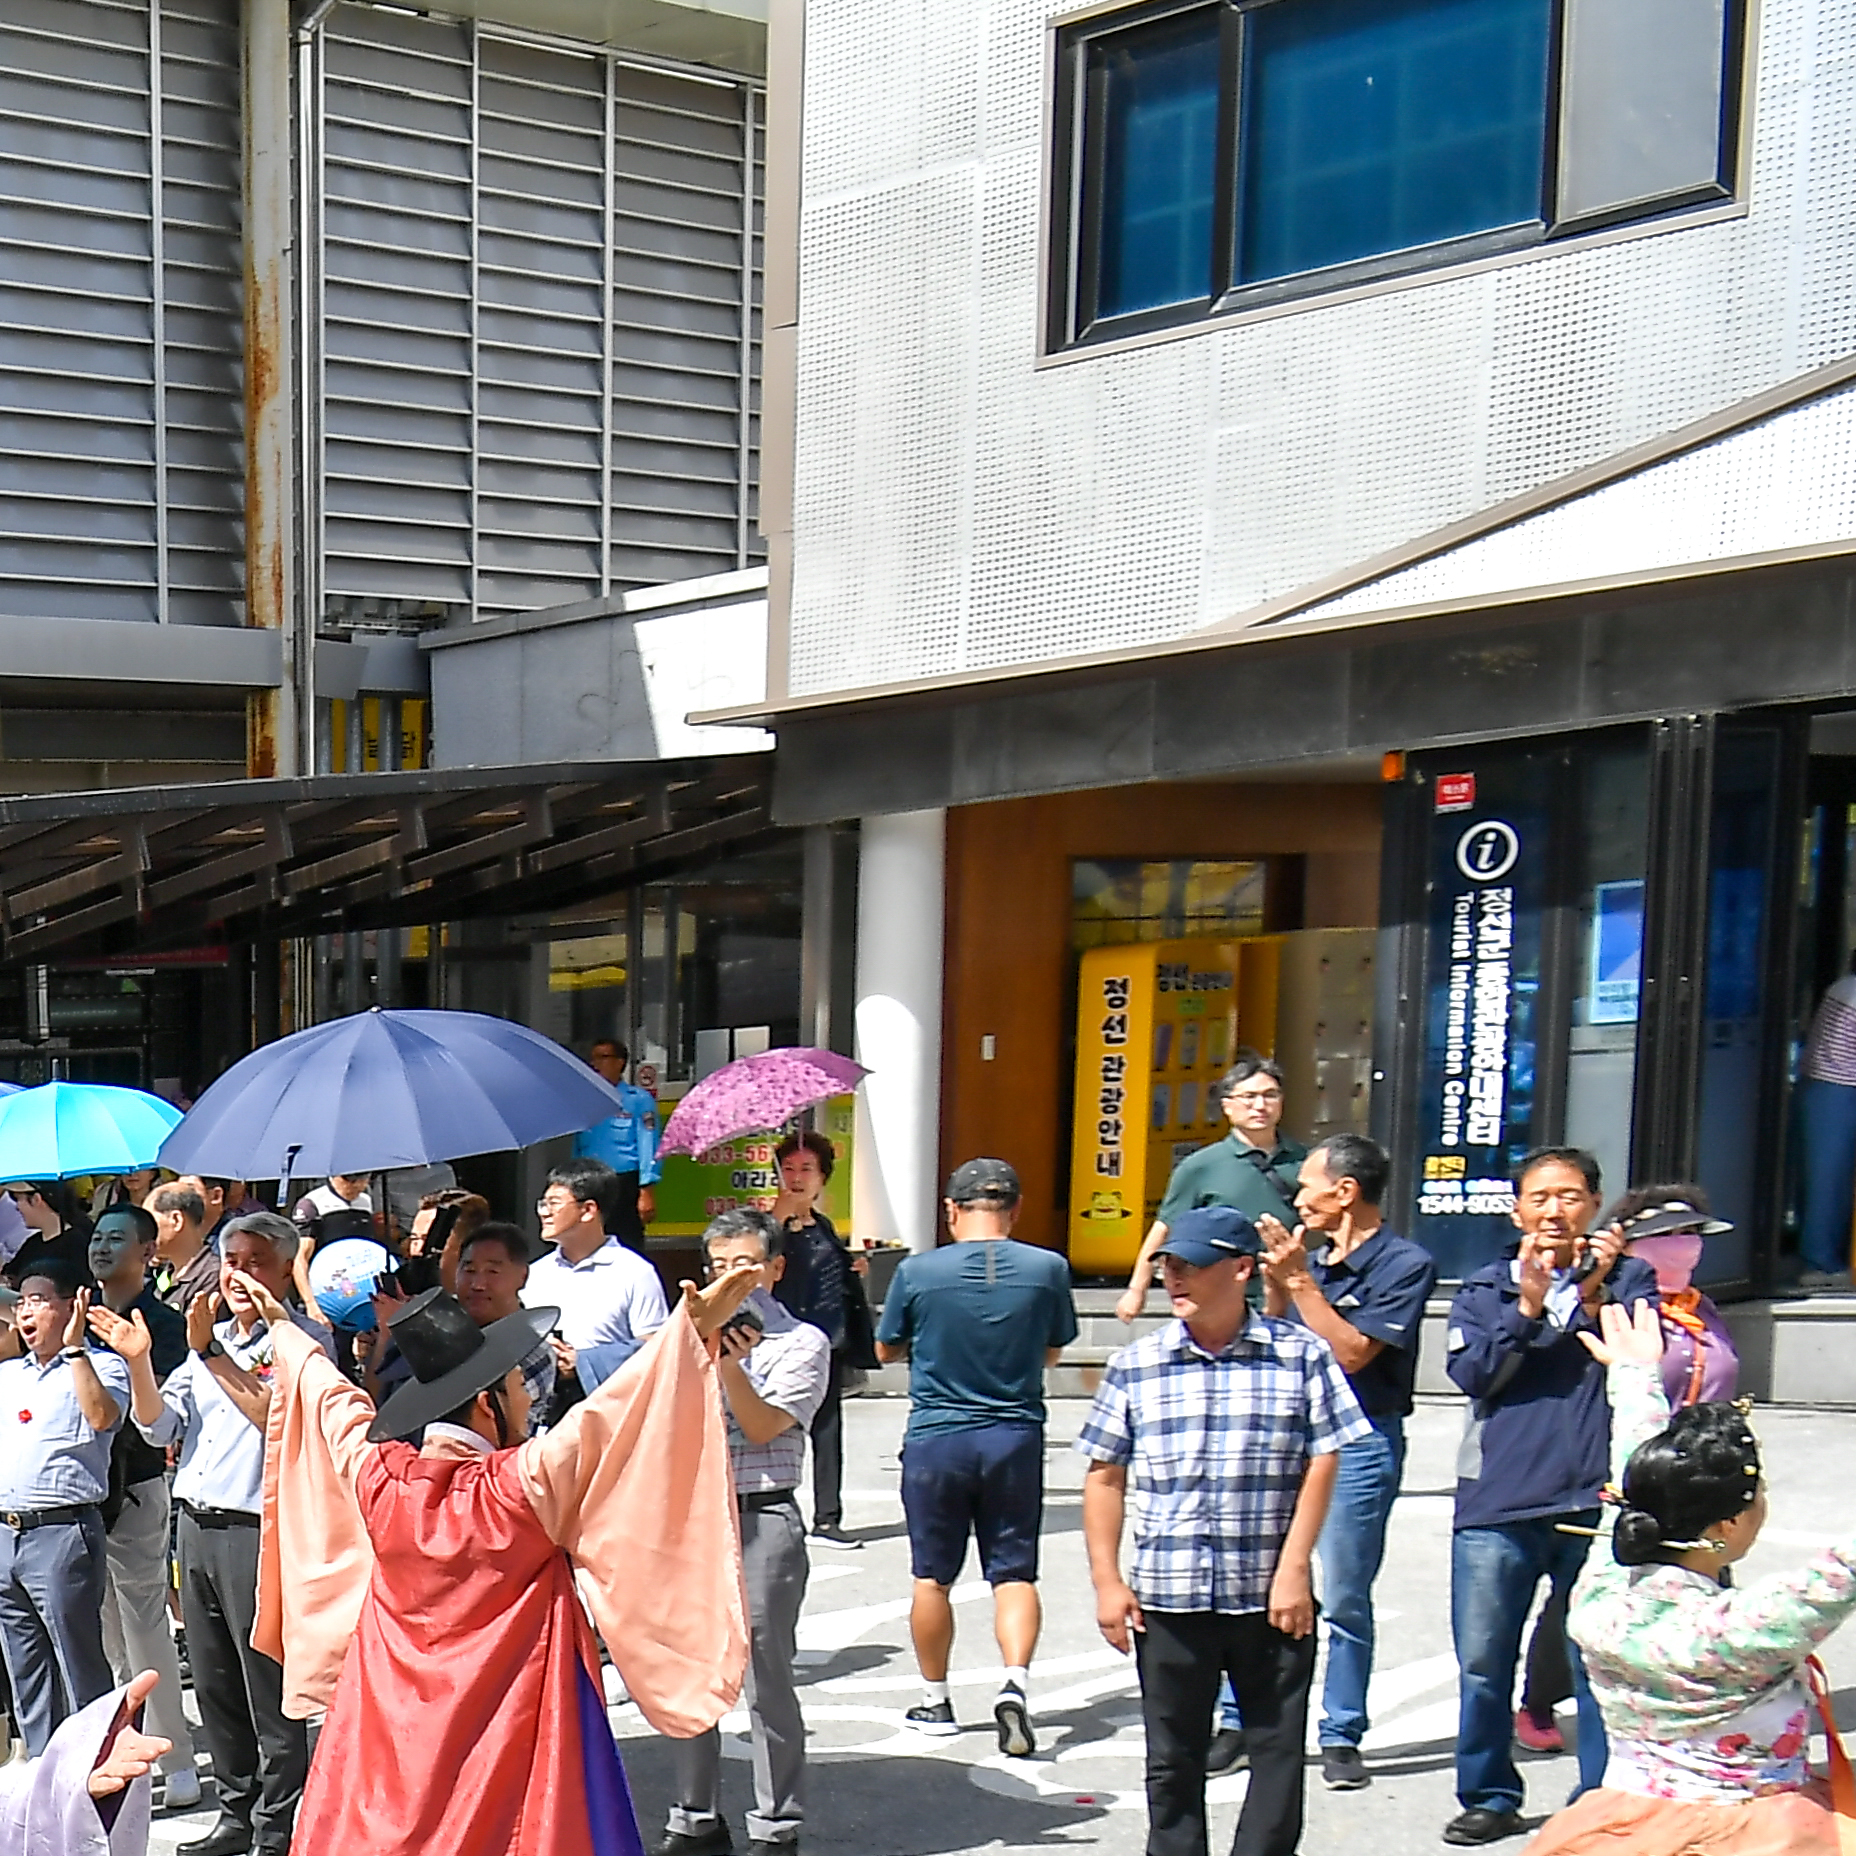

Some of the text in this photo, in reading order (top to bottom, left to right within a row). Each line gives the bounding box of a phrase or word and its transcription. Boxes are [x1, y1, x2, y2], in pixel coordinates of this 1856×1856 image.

[1451, 891, 1475, 959] Tourist
[1445, 963, 1472, 1076] Information
[1095, 976, 1131, 1179] 정선 관광안내
